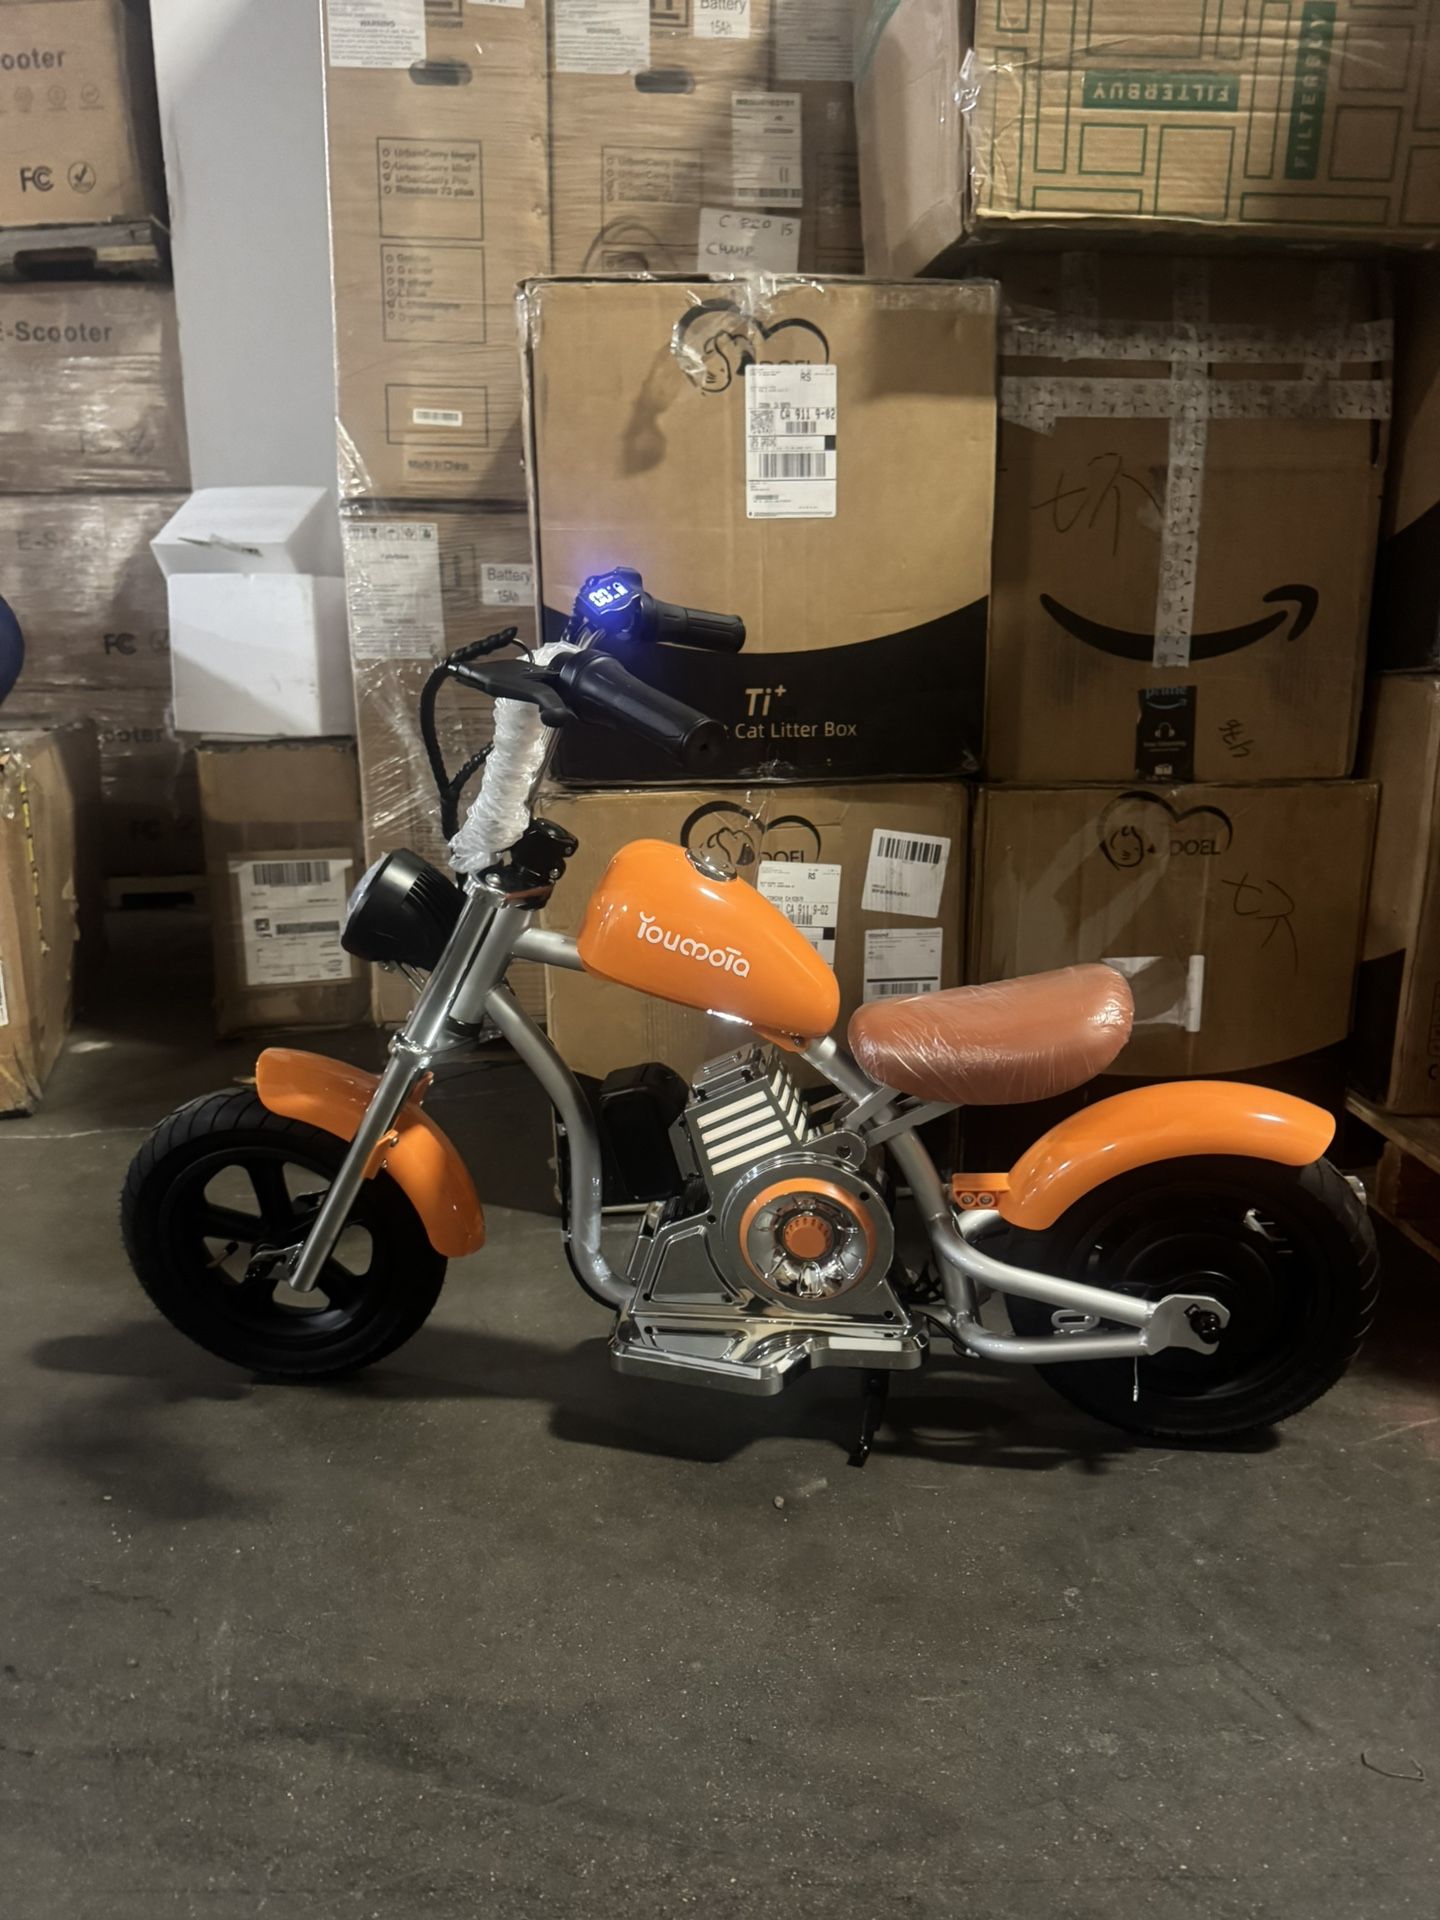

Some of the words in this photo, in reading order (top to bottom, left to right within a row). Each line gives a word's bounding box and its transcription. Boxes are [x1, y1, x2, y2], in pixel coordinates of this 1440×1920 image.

[1094, 82, 1230, 102] FILTERBUY
[0, 320, 112, 342] -Scooter
[487, 567, 530, 586] Battery
[735, 723, 765, 739] Cat
[771, 722, 818, 738] Litter
[824, 721, 857, 737] Box
